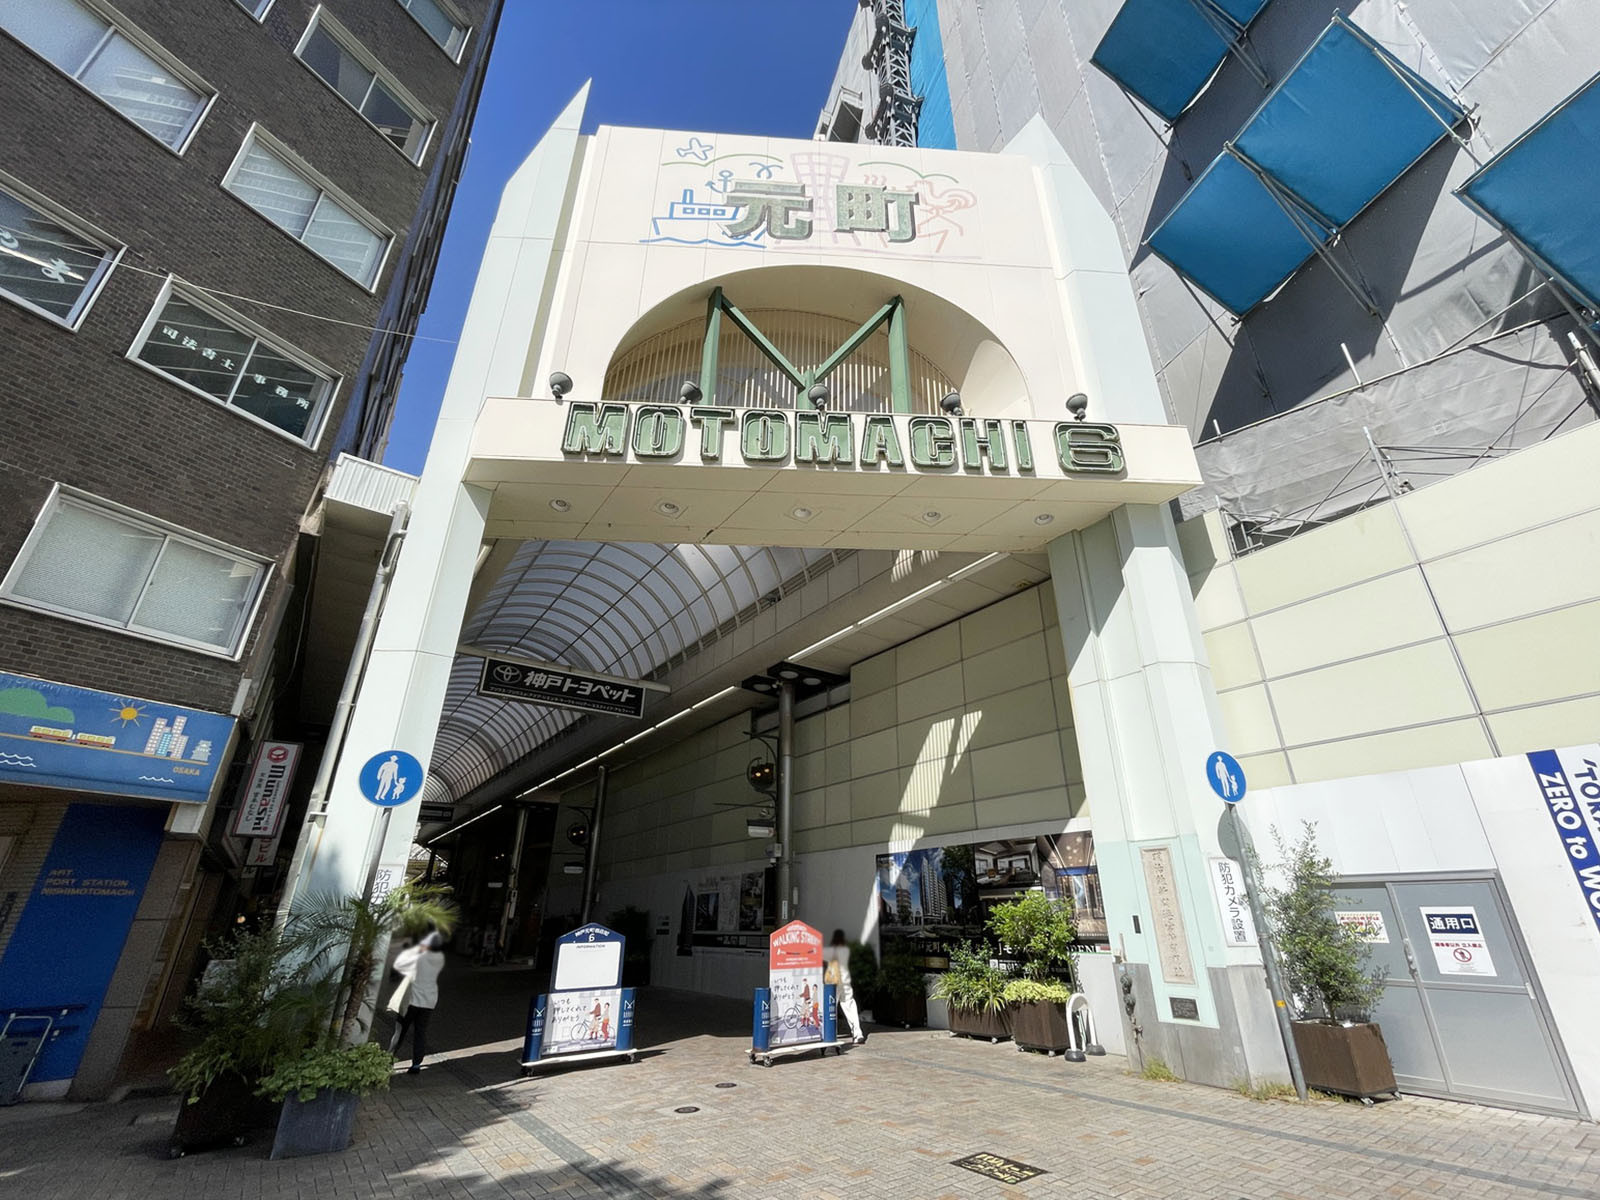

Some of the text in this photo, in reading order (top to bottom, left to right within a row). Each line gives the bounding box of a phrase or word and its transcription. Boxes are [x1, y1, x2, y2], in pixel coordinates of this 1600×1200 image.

[717, 179, 920, 243] 元町
[562, 401, 1127, 474] MOTOMACHI 6
[524, 670, 636, 702] 神戸トヨペット
[172, 766, 201, 777] OSAKA
[252, 764, 287, 832] Munashi
[1538, 771, 1582, 830] ZERO
[1565, 835, 1589, 860] to
[48, 868, 73, 877] ART
[45, 878, 130, 887] PORT STATION
[370, 868, 392, 906] 防犯カ
[40, 887, 136, 896] NISHIMOTOMACHI
[1217, 861, 1248, 943] 防犯カメラ設置
[1430, 916, 1476, 931] 通用口
[588, 933, 596, 943] 6
[774, 976, 788, 984] いつも
[553, 997, 572, 1005] いつも
[773, 992, 796, 1001] ありがとう
[552, 1006, 588, 1015] 押してくれて
[551, 1015, 580, 1025] ありがとう
